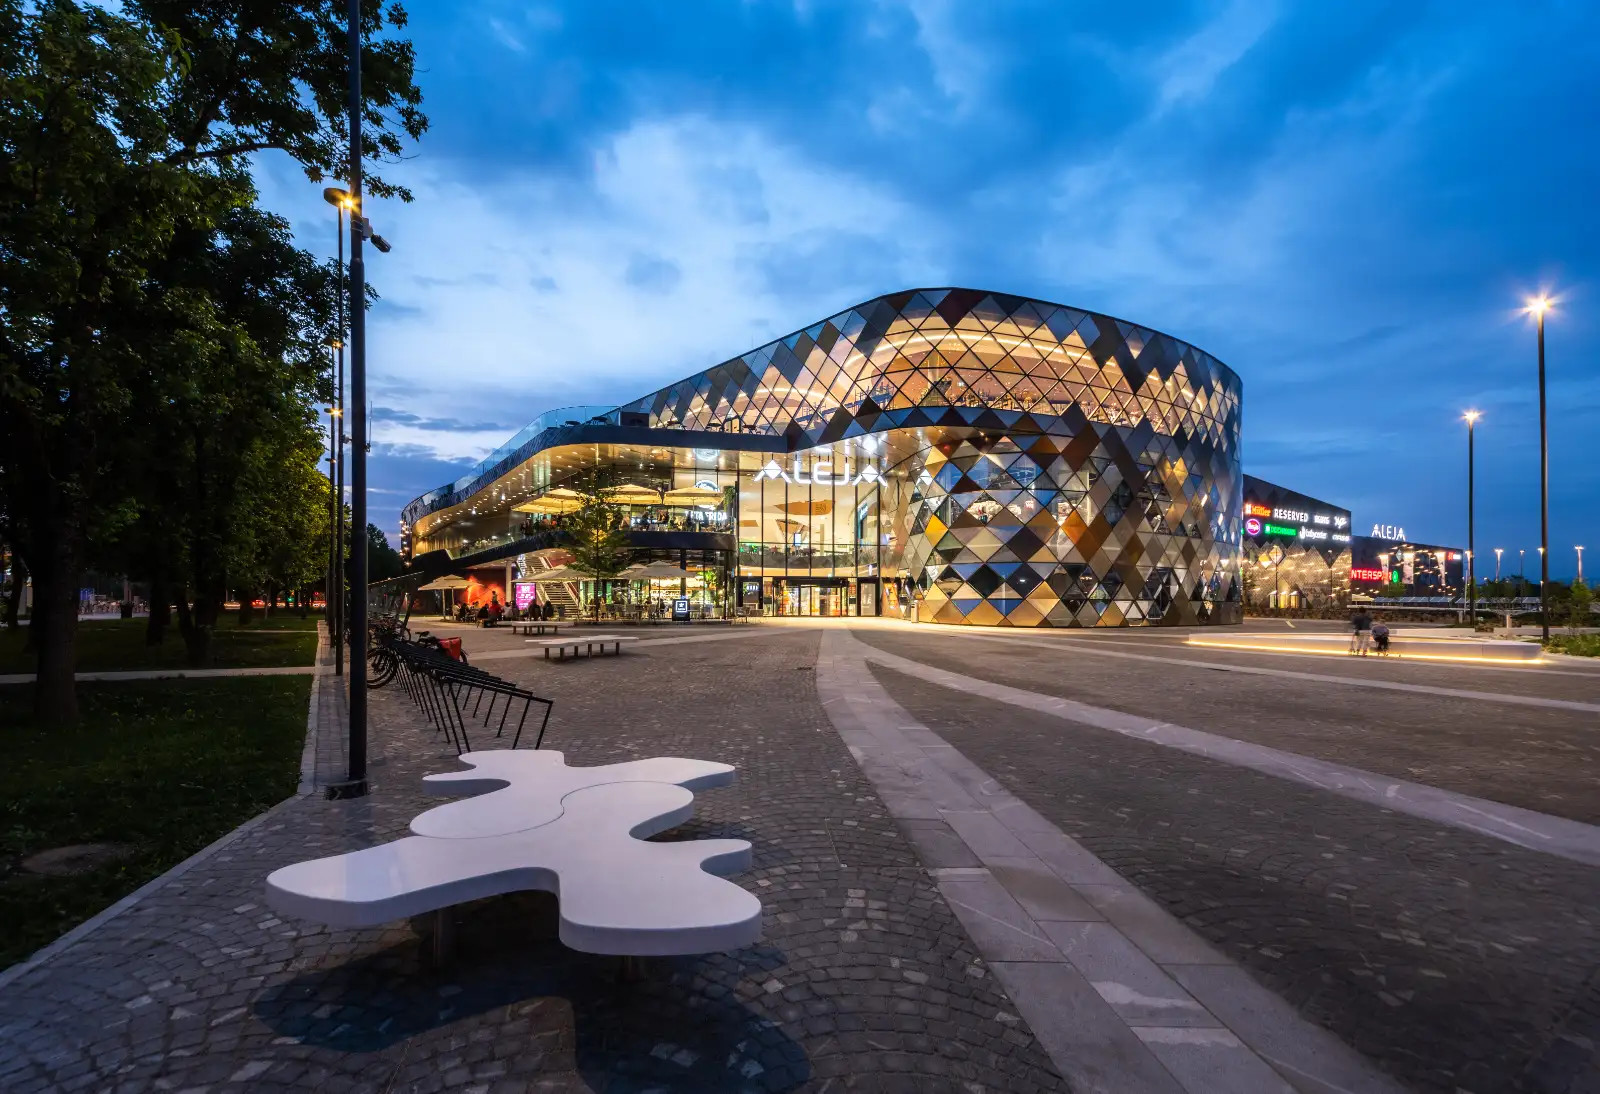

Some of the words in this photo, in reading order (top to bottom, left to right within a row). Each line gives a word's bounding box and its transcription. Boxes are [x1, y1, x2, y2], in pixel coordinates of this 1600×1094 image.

[753, 459, 888, 488] ALEJA
[1274, 508, 1308, 522] RESERVED
[1371, 523, 1406, 541] ALEJA
